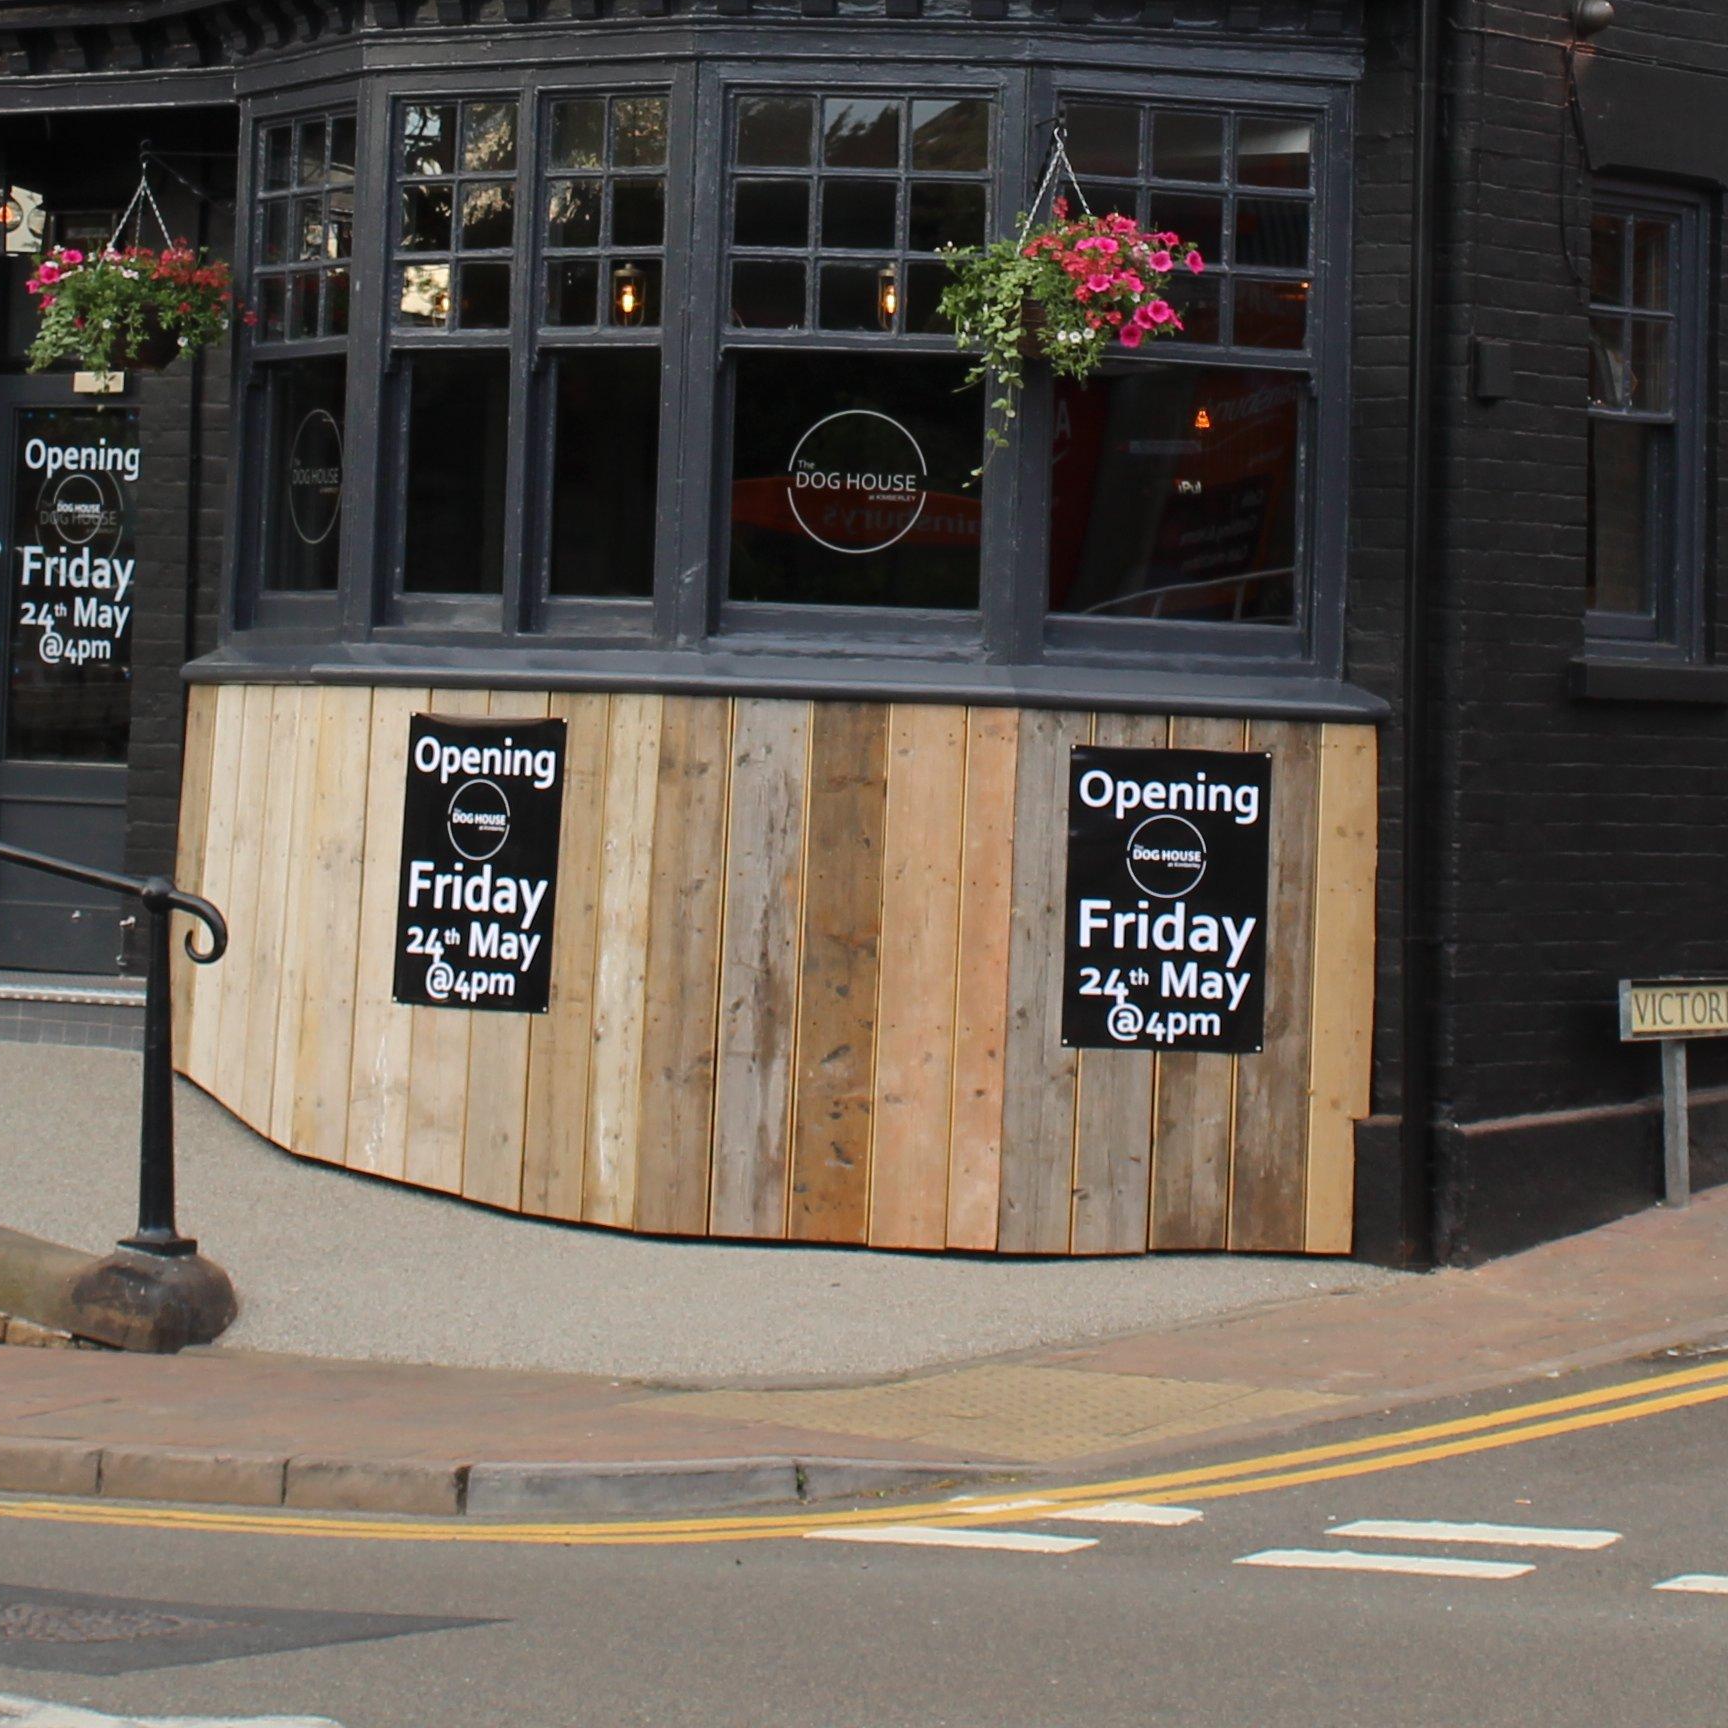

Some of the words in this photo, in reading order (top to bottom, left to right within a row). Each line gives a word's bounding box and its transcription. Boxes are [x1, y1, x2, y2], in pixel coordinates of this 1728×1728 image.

[24, 438, 141, 481] Opening
[796, 471, 841, 490] DOG
[846, 473, 917, 492] HOUSE
[21, 545, 135, 602] Friday
[20, 601, 68, 635] 24th
[73, 596, 131, 638] May
[39, 632, 111, 666] @4pm
[414, 735, 557, 790] Opening
[452, 812, 474, 825] DOG
[474, 813, 506, 826] HOUSE
[1079, 769, 1260, 826] Opening
[1132, 849, 1160, 861] DOG
[1161, 850, 1202, 863] HOUSE
[408, 860, 549, 931] Friday
[406, 926, 461, 964] 24th
[468, 921, 541, 972] May
[1078, 898, 1257, 969] Friday
[425, 961, 516, 1003] @4pm
[1078, 966, 1150, 1006] 24th
[1160, 960, 1252, 1012] May
[1106, 1002, 1222, 1045] @4pm
